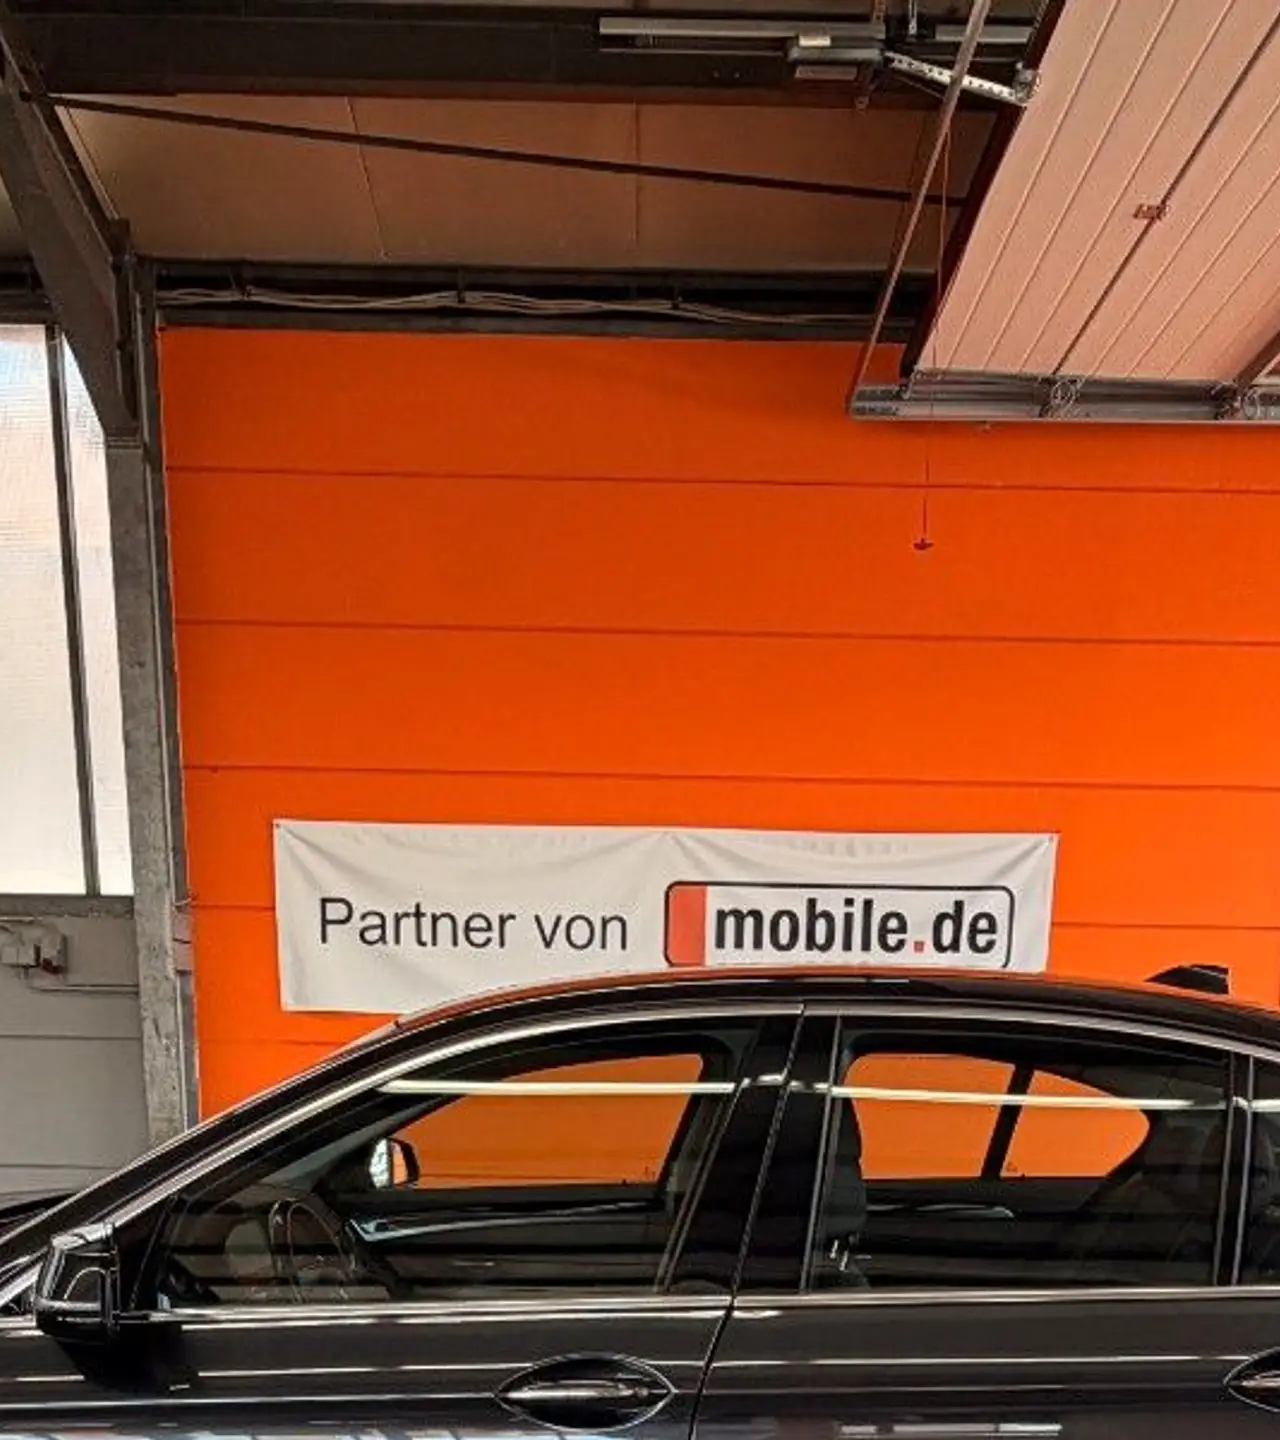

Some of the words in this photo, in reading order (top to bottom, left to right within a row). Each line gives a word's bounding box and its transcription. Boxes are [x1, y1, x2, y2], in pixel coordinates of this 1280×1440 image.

[319, 897, 516, 949] Partner
[533, 913, 628, 951] von
[714, 897, 999, 954] mobile.de
